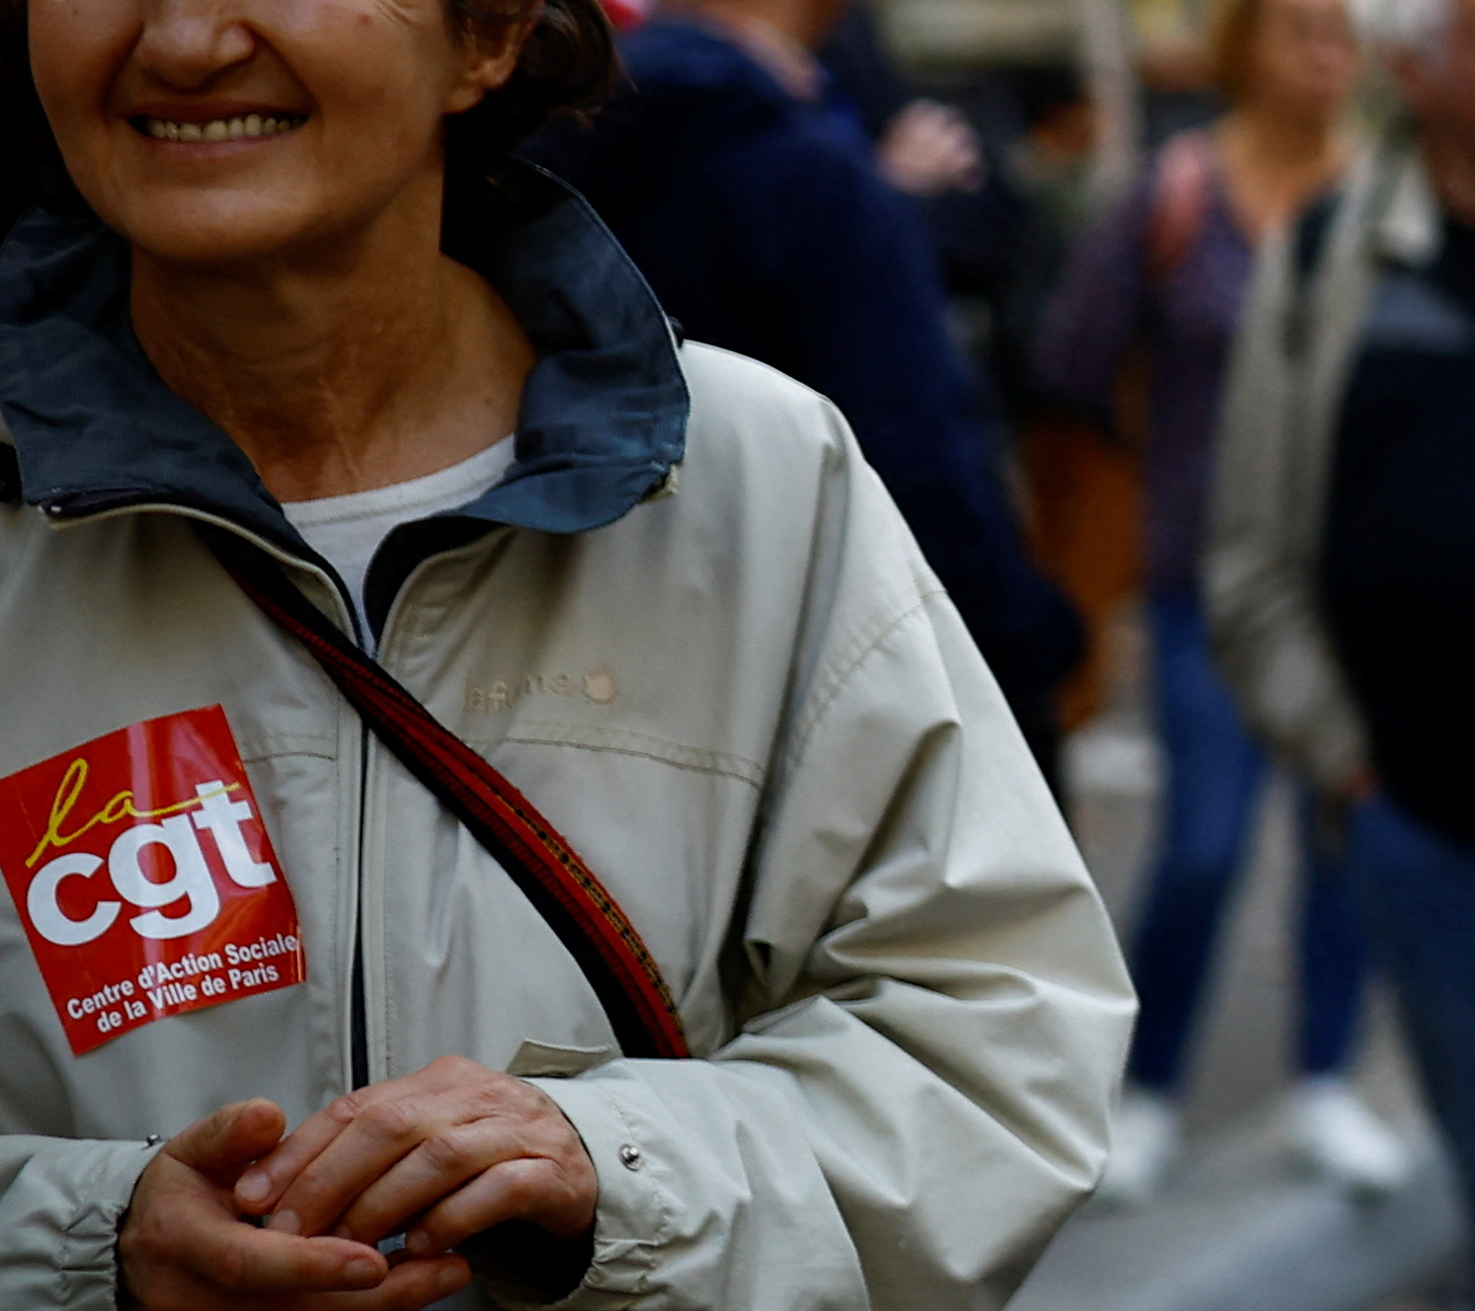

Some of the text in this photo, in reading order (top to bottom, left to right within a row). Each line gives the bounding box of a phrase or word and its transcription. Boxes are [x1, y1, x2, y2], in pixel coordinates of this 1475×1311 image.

[25, 757, 240, 868] la
[27, 779, 278, 946] cgt
[67, 933, 299, 1020] Centre d'Action Sociale
[96, 962, 279, 1033] de la Ville de Paris
